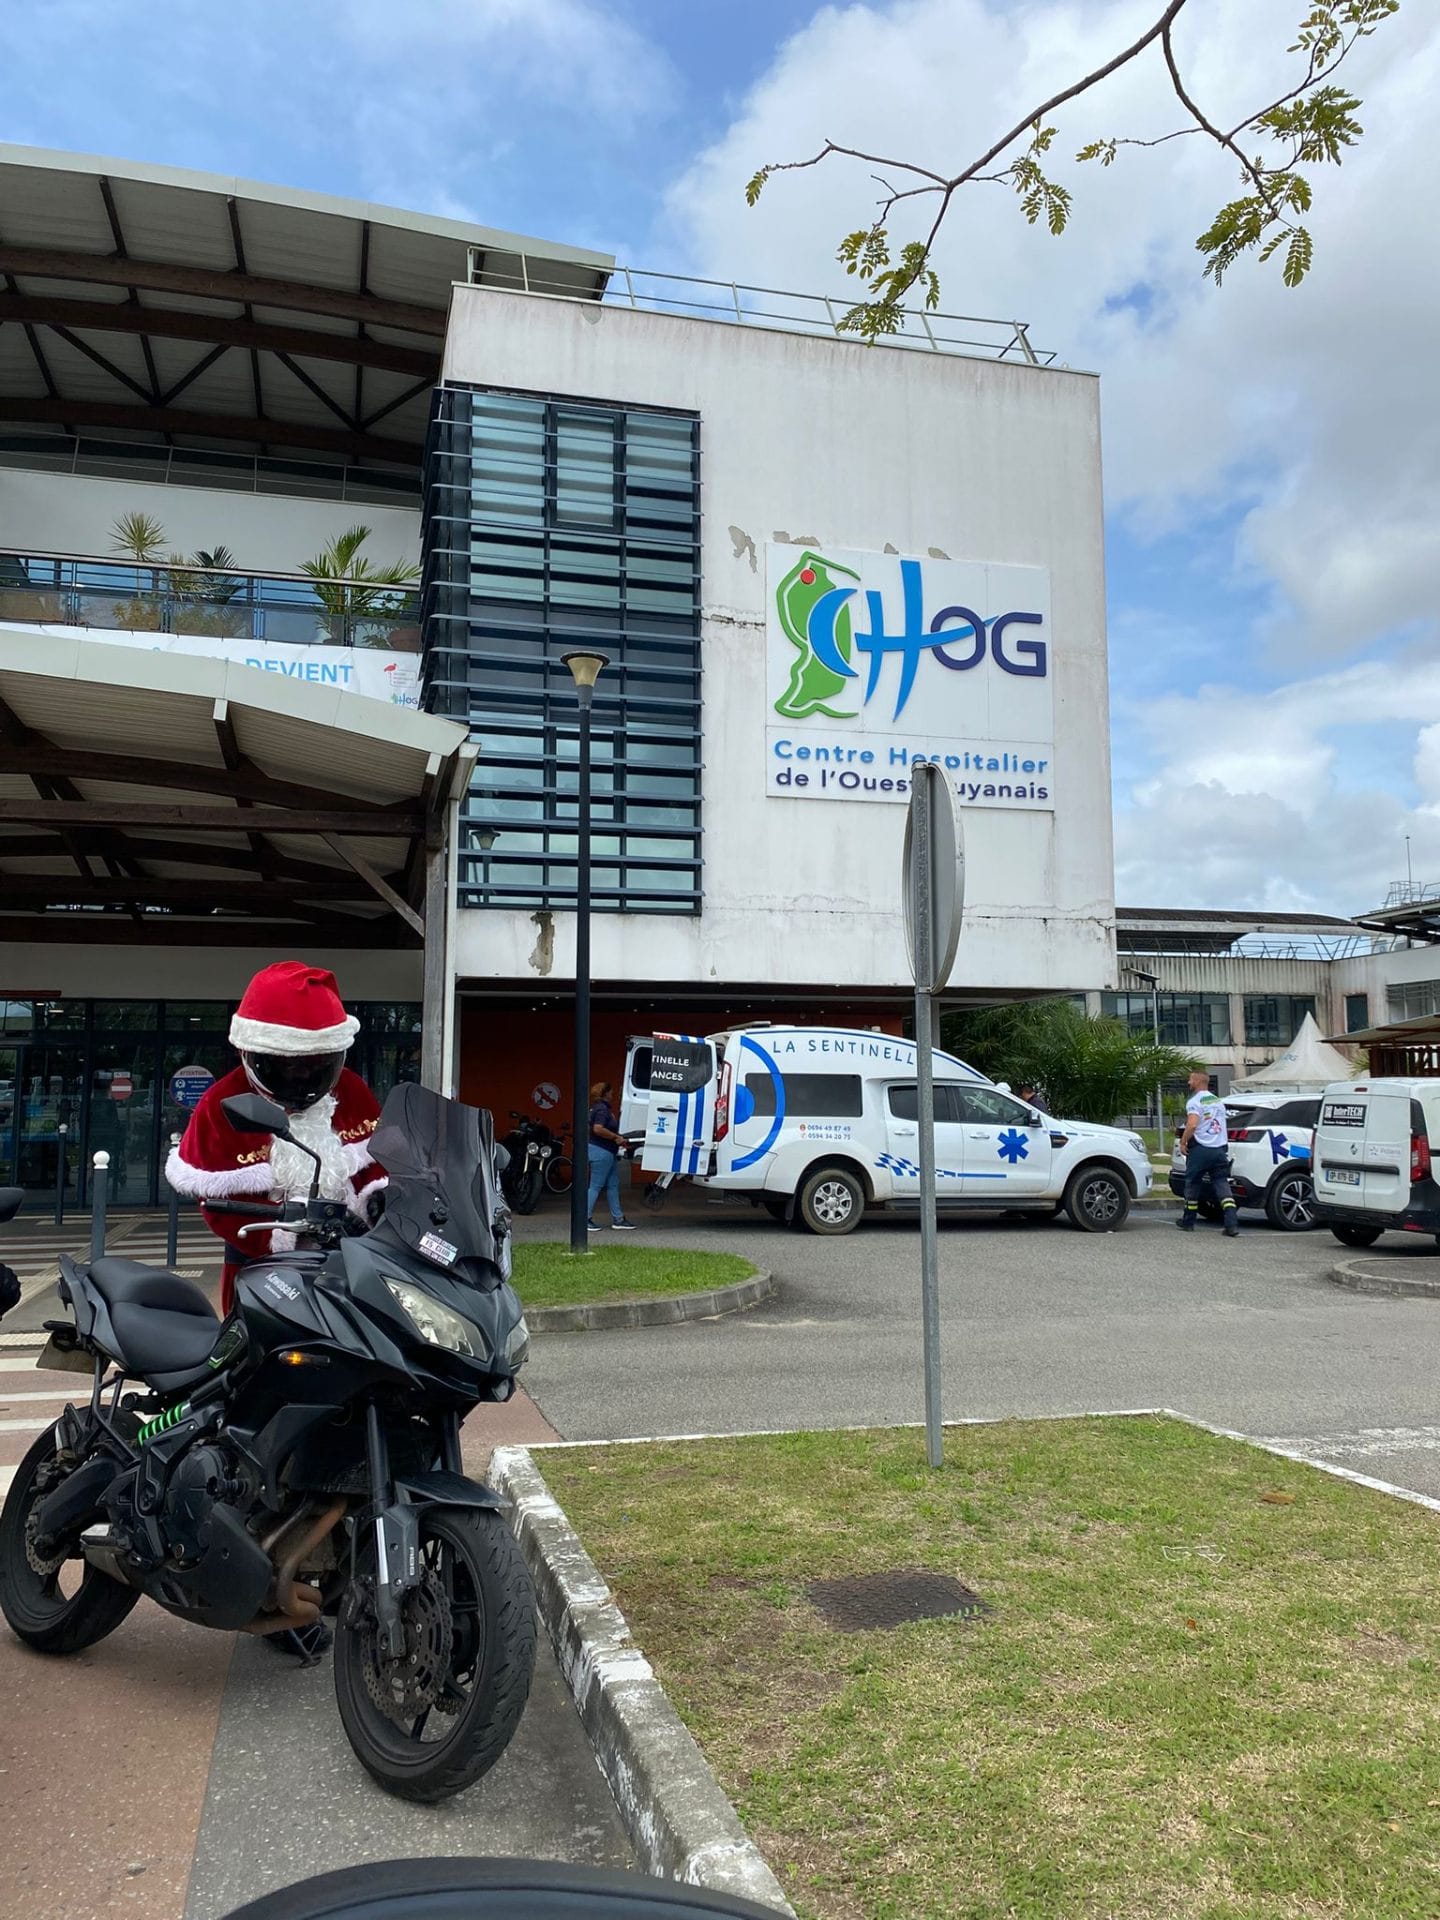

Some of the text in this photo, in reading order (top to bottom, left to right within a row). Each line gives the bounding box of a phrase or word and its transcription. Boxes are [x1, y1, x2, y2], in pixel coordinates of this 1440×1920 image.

[808, 559, 1047, 722] CHOG
[774, 740, 1049, 774] Centre Hospitalier
[775, 767, 1049, 801] de l'Oues uyanais
[773, 1039, 915, 1065] LA SENTINELL
[651, 1070, 684, 1081] ANCES
[264, 1270, 301, 1301] Kawasaki
